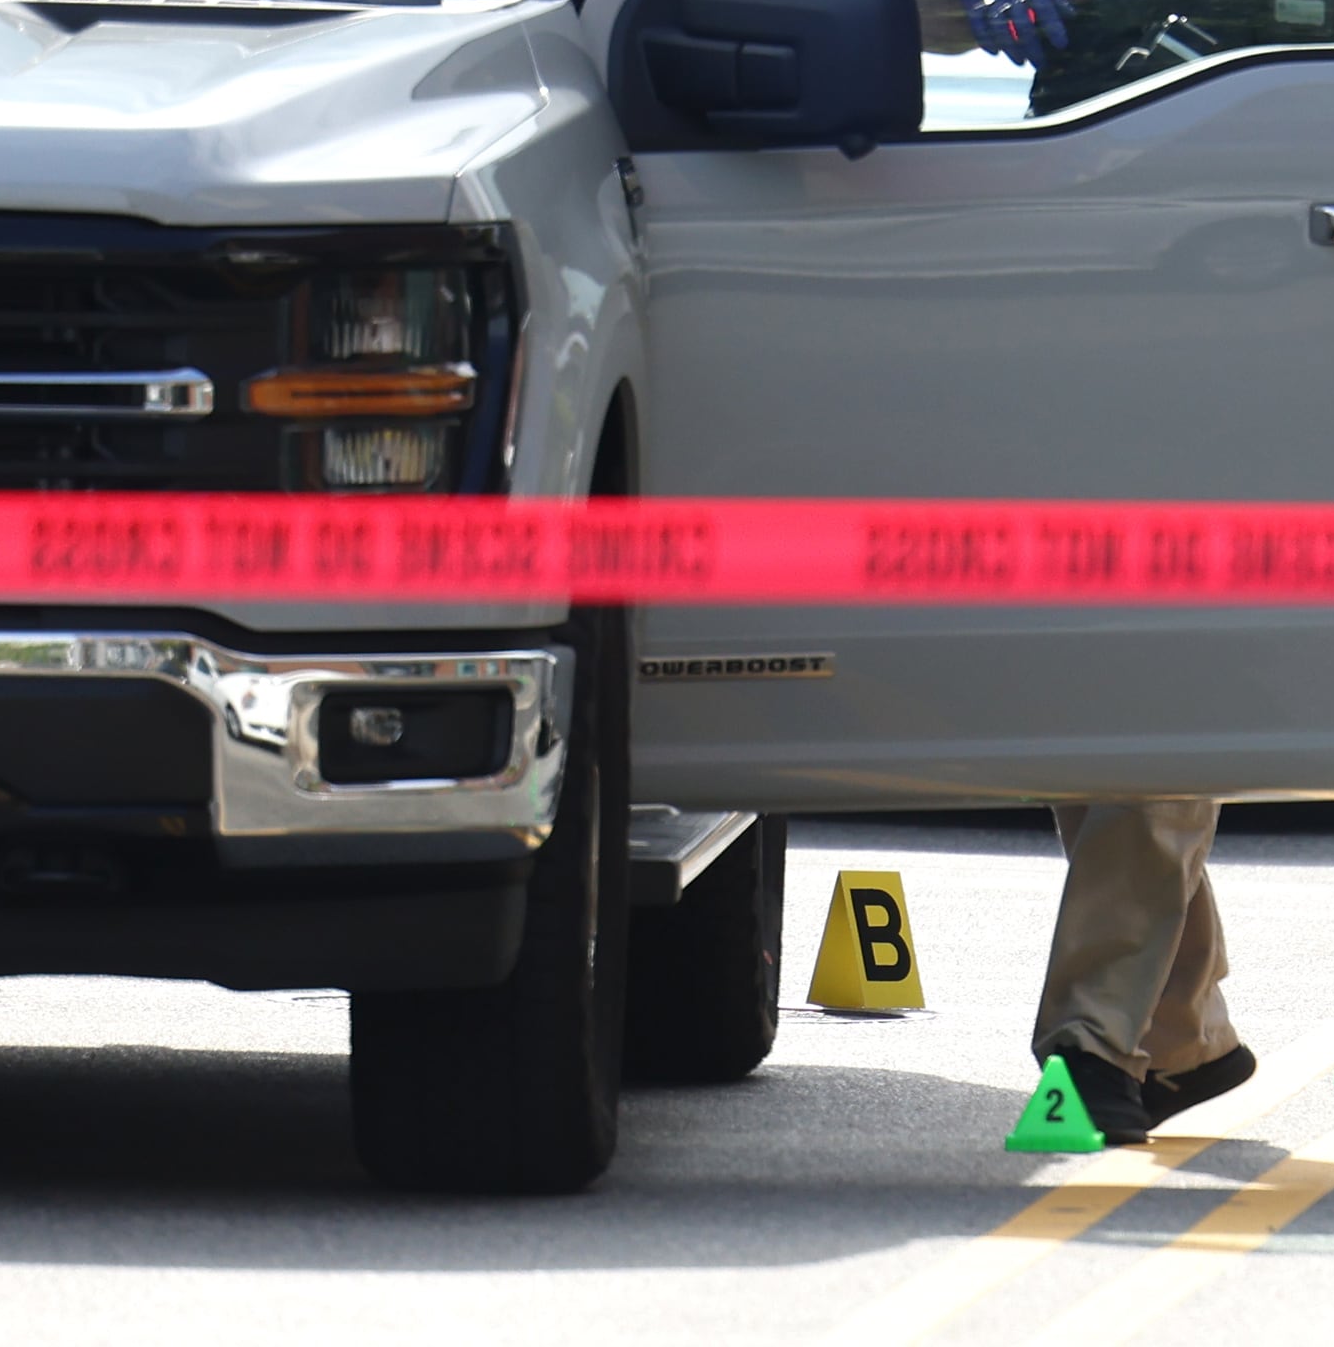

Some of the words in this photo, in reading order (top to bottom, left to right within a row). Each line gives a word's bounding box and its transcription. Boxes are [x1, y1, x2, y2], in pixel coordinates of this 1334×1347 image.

[640, 657, 827, 677] OWERBOOST
[849, 888, 912, 982] B
[1045, 1088, 1065, 1123] 2
